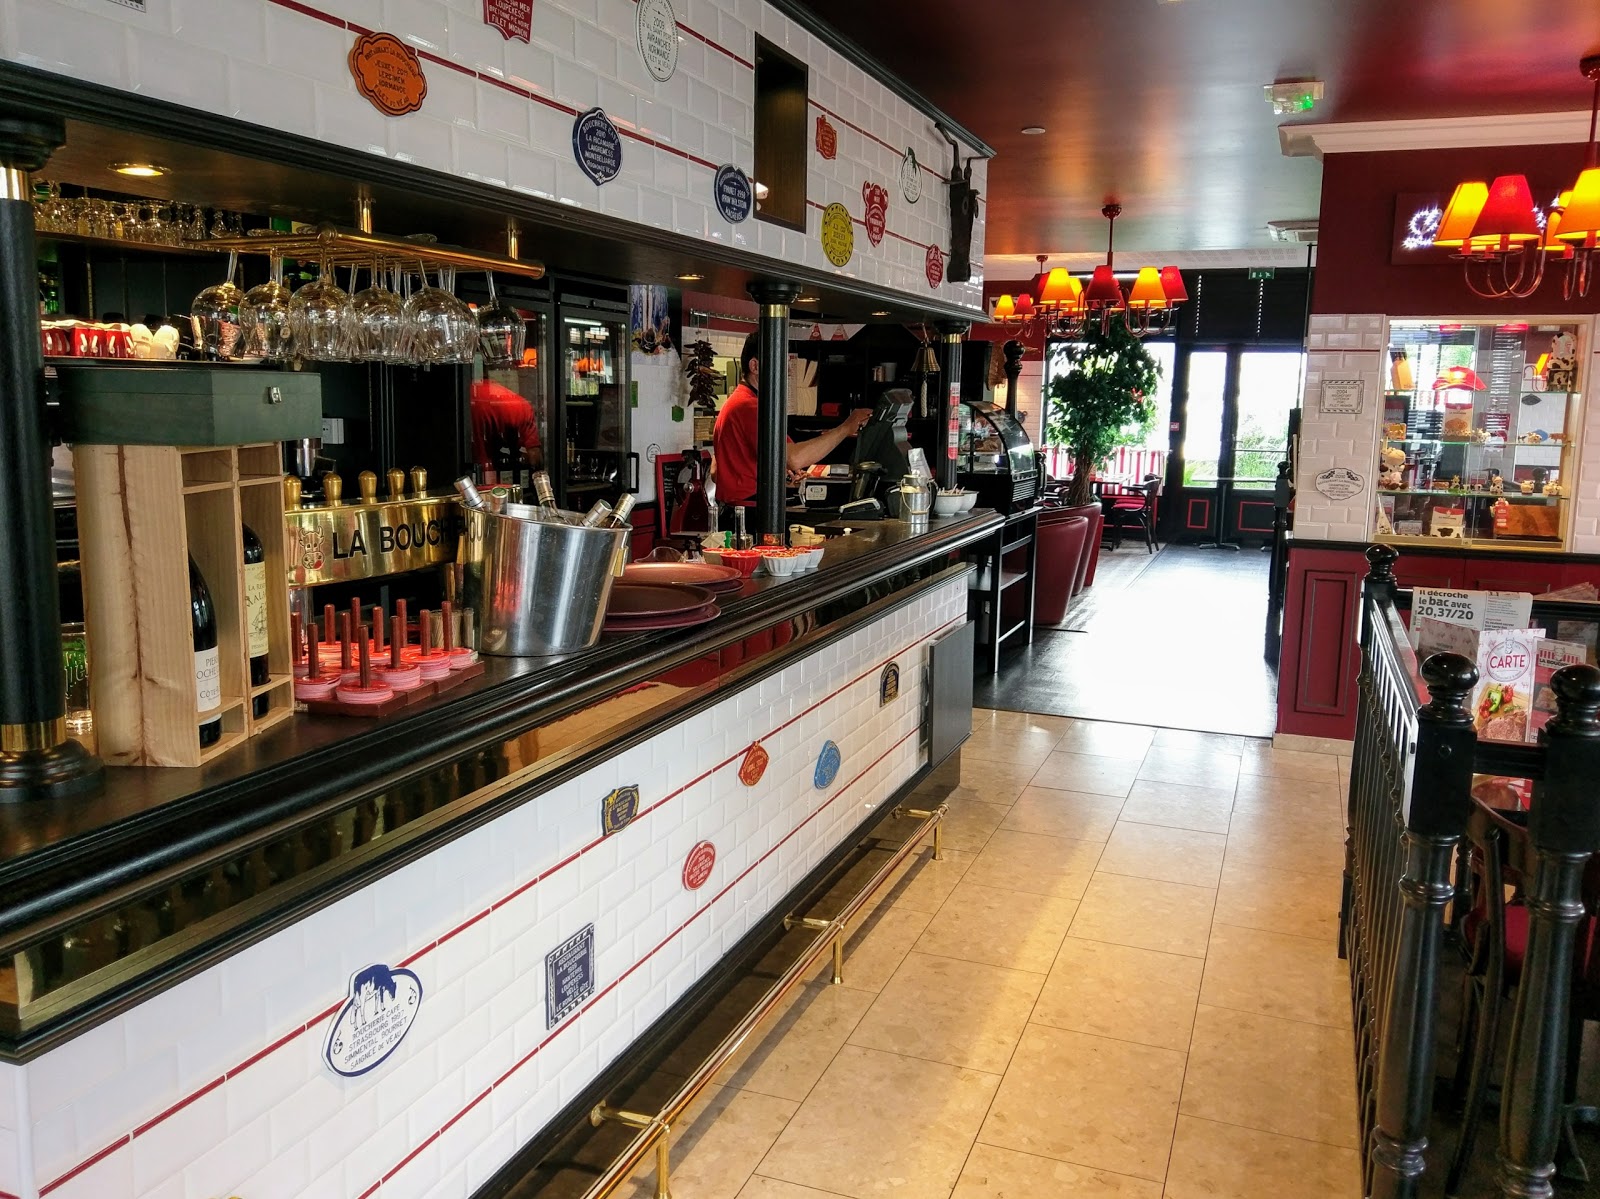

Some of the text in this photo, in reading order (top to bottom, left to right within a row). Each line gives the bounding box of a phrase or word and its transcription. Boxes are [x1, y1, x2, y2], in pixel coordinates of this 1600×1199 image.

[492, 14, 507, 28] FILET
[332, 529, 367, 560] LA
[1428, 589, 1469, 599] décroche
[1418, 596, 1472, 610] le bac avec
[1417, 606, 1474, 620] 20,37/20
[1490, 654, 1526, 668] CARTE
[558, 941, 586, 966] RESTAURANT
[352, 1003, 400, 1041] BOUCHERIE CAFE
[344, 1016, 408, 1064] SIMMENTAL BOURRET
[349, 1020, 389, 1052] STRASBOURG
[385, 1030, 402, 1045] VEAU
